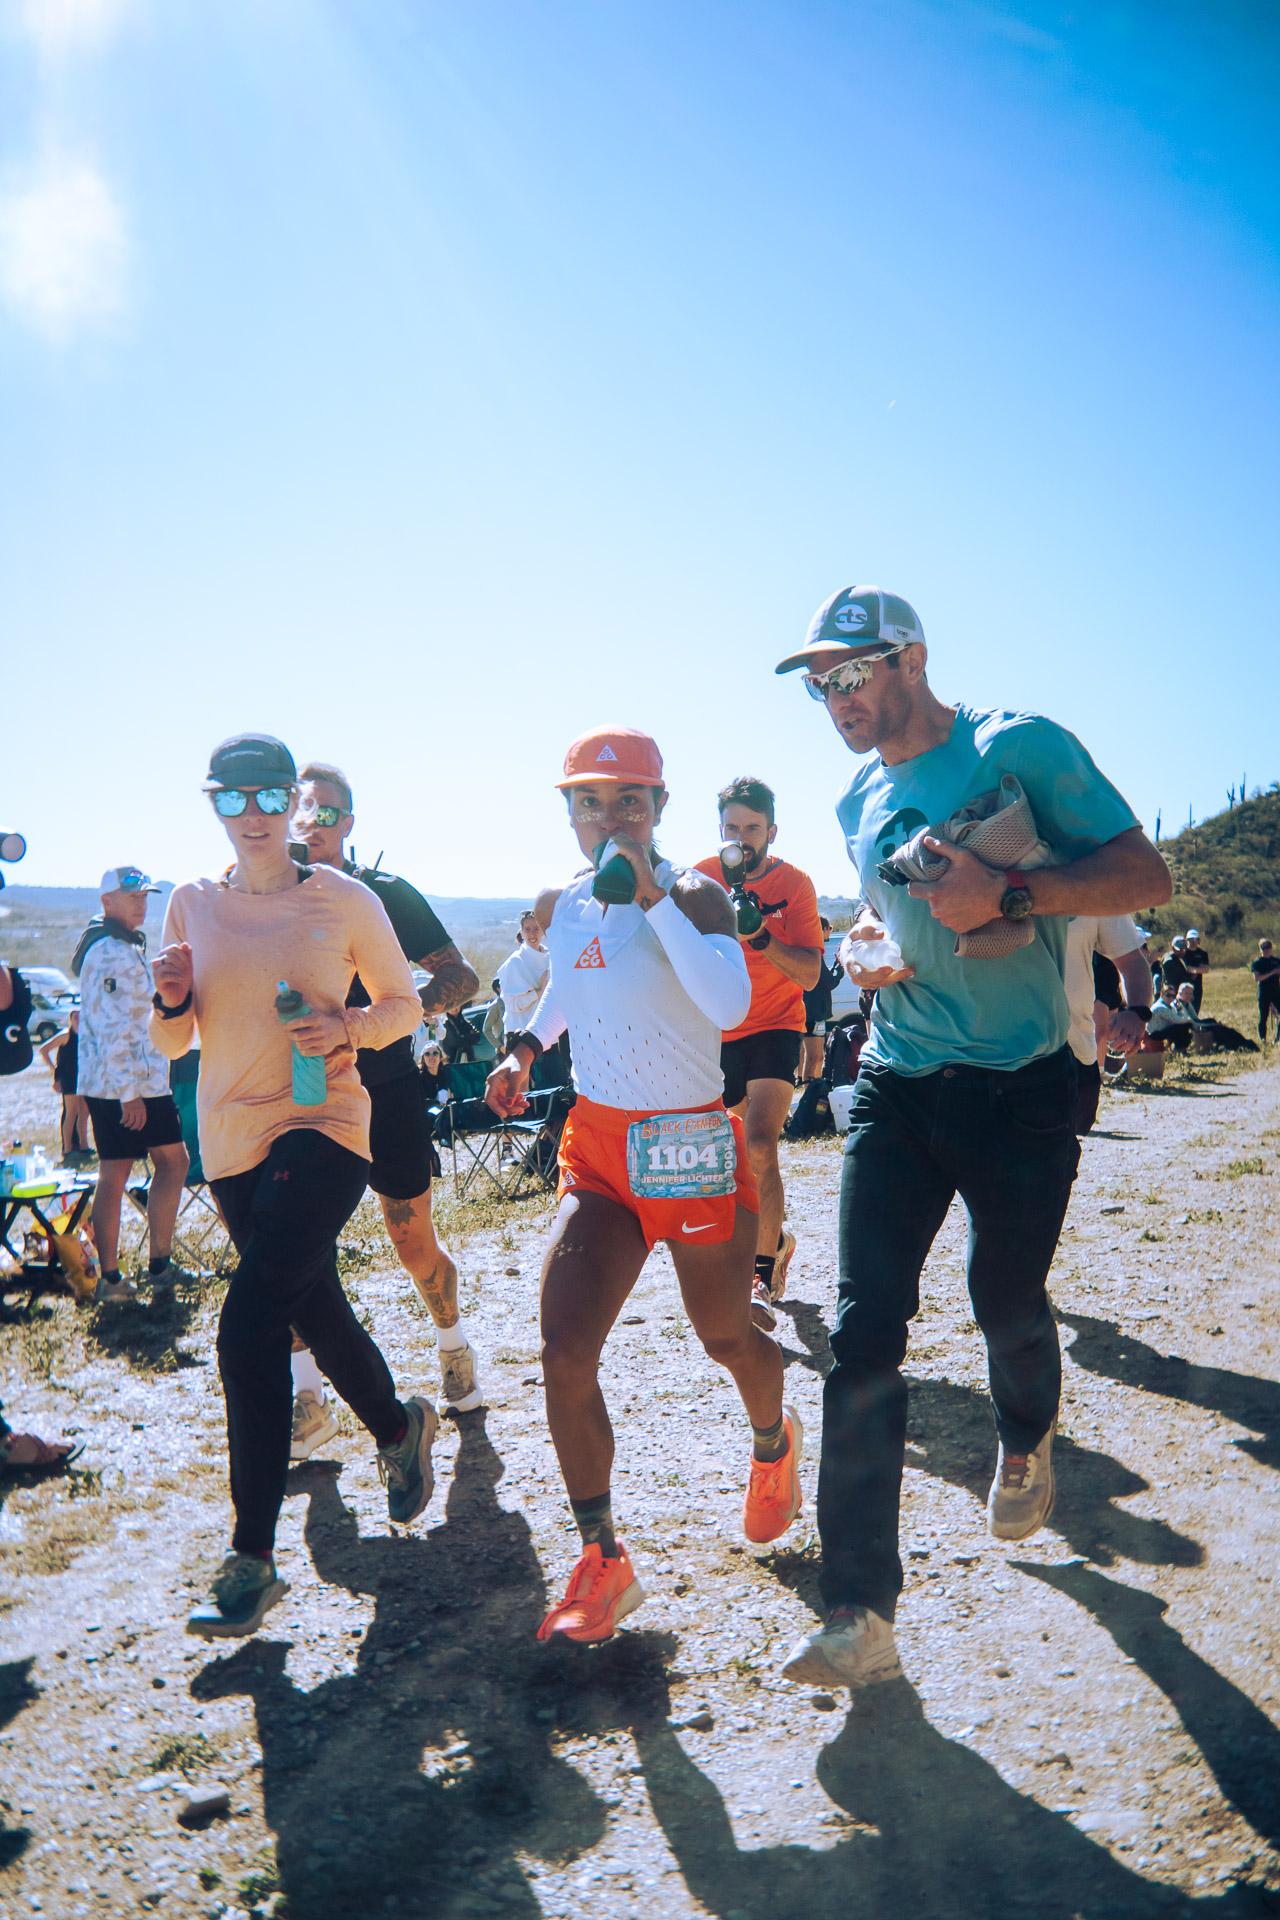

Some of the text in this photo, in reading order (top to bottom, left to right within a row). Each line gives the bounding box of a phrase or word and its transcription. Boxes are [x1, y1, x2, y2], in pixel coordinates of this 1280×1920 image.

[641, 1121, 681, 1139] BLACK
[647, 1143, 719, 1170] 1104
[641, 1175, 685, 1184] JENNIFER
